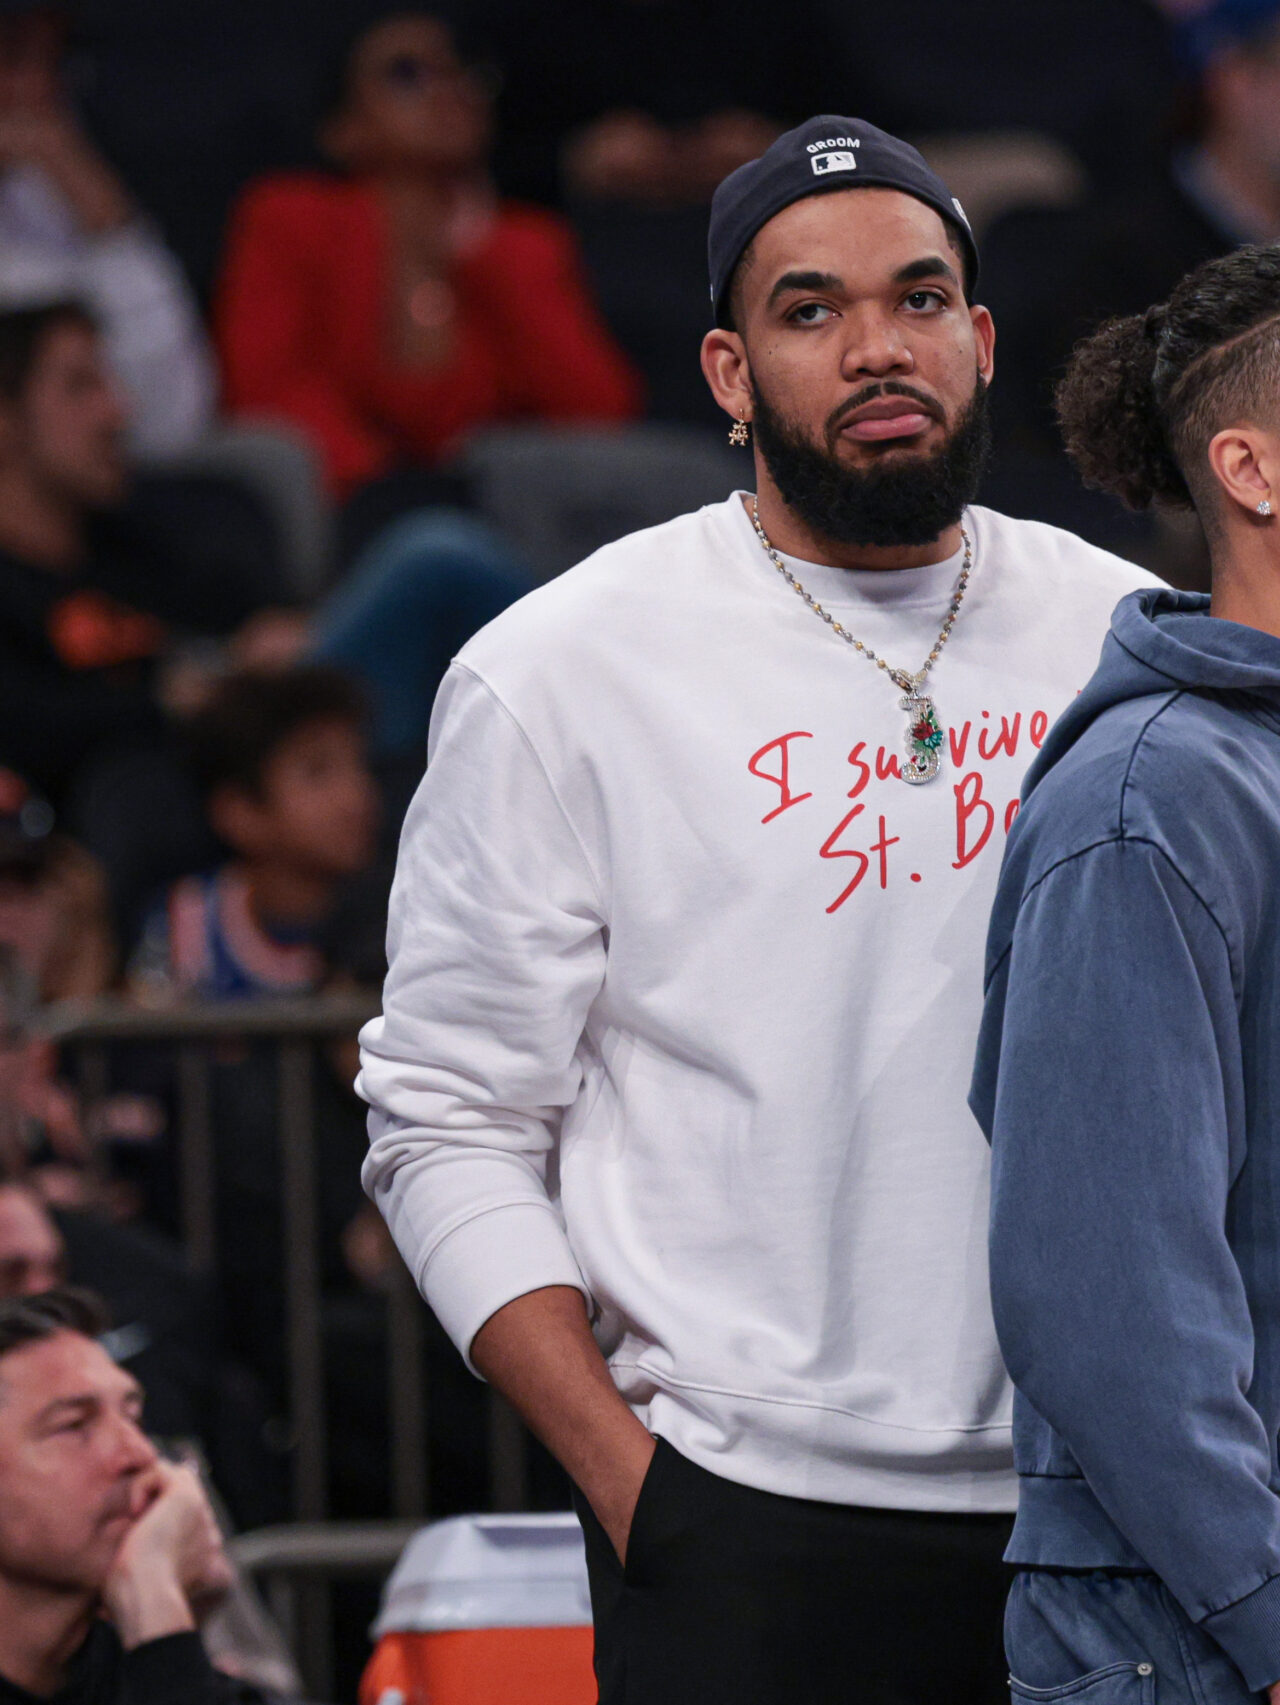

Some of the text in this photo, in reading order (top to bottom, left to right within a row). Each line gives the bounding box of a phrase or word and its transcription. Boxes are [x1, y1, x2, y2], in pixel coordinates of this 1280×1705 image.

[806, 137, 860, 153] GROOM
[748, 690, 1082, 824] I suvive
[819, 803, 922, 914] St.
